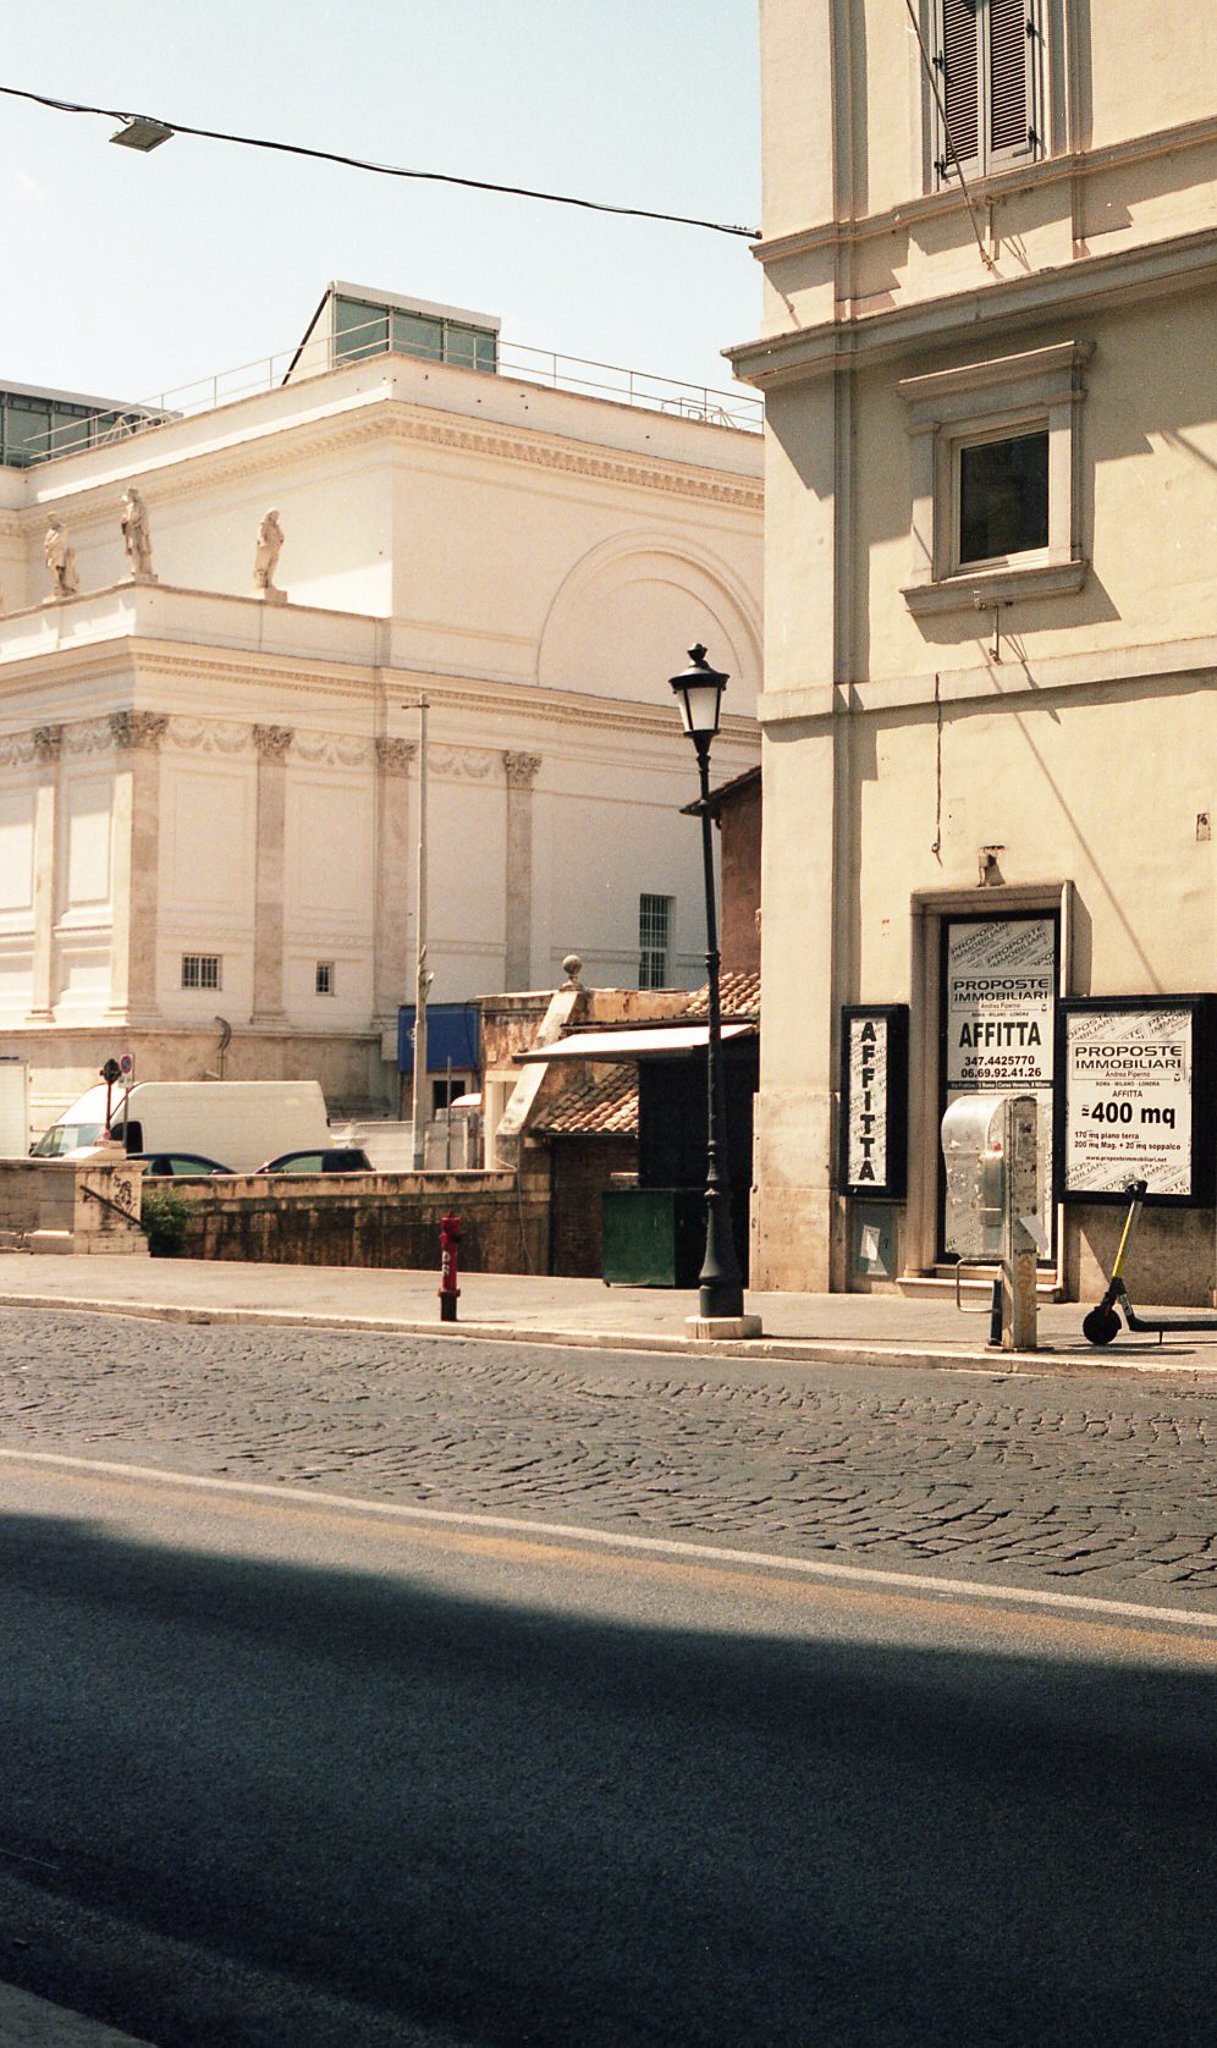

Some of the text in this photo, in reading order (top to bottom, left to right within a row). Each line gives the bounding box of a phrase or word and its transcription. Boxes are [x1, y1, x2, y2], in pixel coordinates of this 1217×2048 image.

[954, 979, 1049, 991] PROPOSTE
[954, 991, 1048, 1002] IMMOBILIARI
[959, 1021, 1042, 1048] AFFITTA
[1075, 1046, 1182, 1057] PROPOSTE
[965, 1056, 1035, 1066] 347.4425770
[1076, 1059, 1181, 1069] IMMOBILIARI
[961, 1068, 1042, 1078] 06.69.92.41.26
[1112, 1090, 1143, 1098] AFFITTA
[859, 1022, 877, 1181] AFFITTA
[1141, 1107, 1175, 1129] mq
[1101, 1142, 1117, 1150] Mag.
[1148, 1143, 1181, 1151] soppalco
